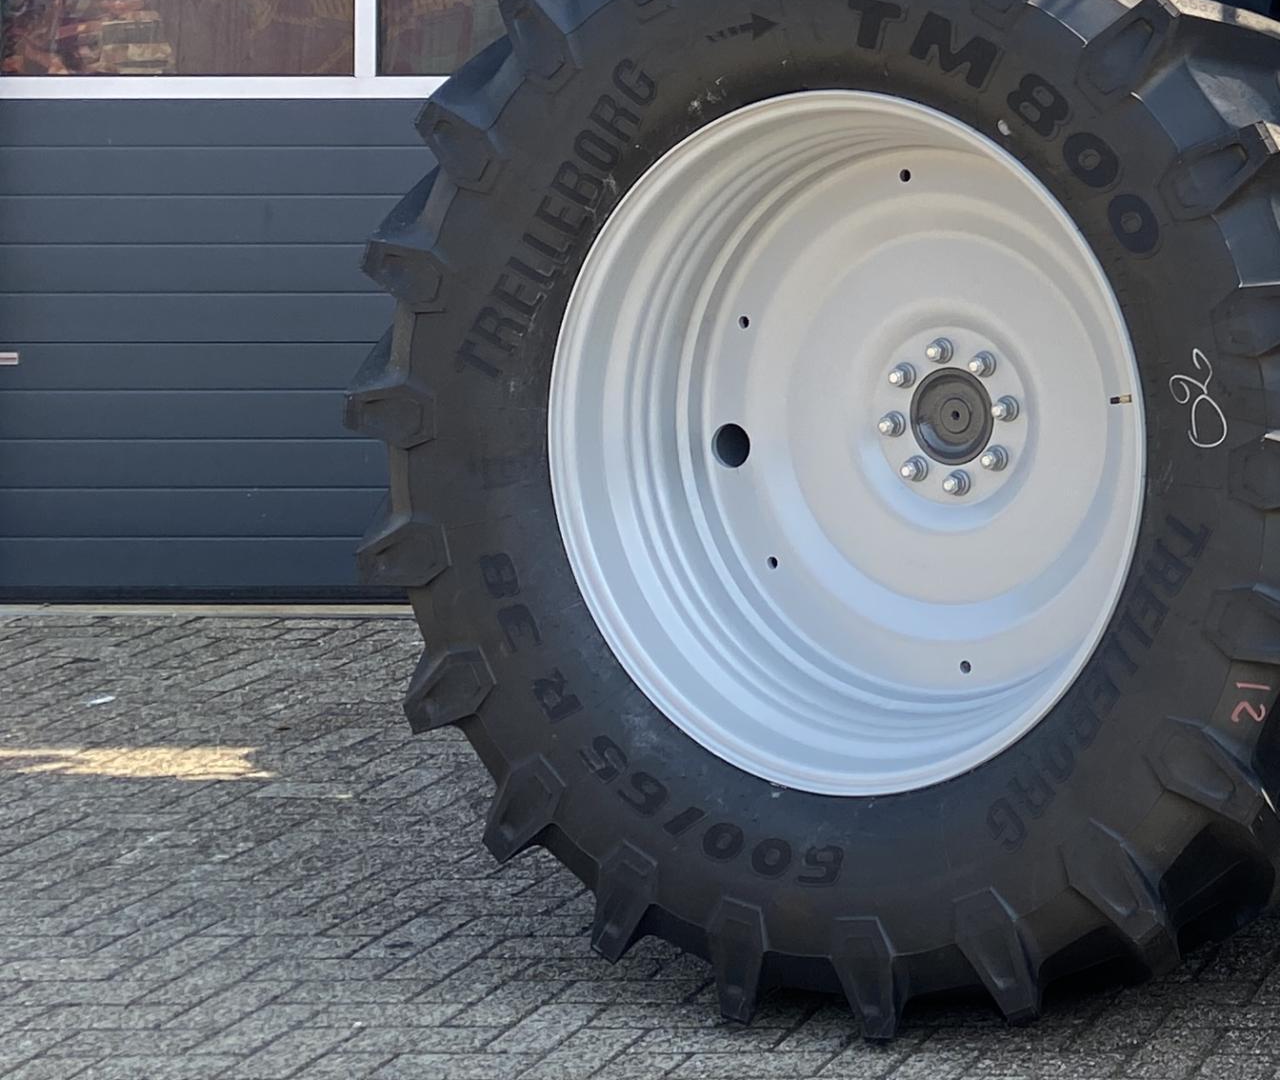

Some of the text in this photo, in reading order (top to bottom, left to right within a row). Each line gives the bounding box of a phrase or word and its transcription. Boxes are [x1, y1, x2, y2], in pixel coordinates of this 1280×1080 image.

[456, 57, 657, 379] TRELLEBORG
[478, 552, 845, 888] 500/65 R 38
[986, 515, 1215, 856] TRELLEBORG
